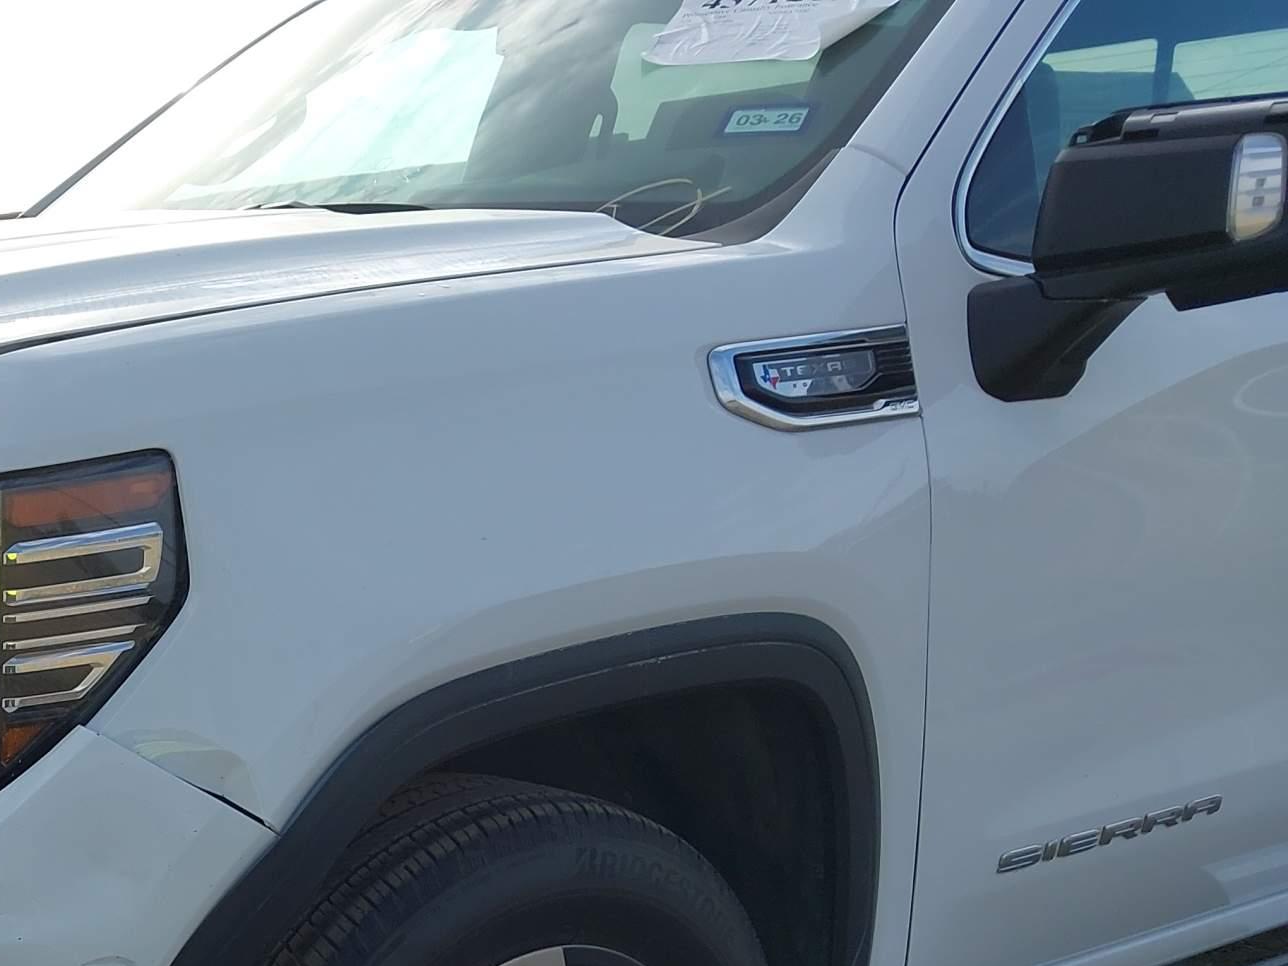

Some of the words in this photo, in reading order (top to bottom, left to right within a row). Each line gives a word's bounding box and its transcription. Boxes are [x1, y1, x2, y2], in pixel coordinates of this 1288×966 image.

[736, 114, 763, 126] 03
[773, 113, 804, 125] 26
[996, 793, 1223, 873] SIERRA
